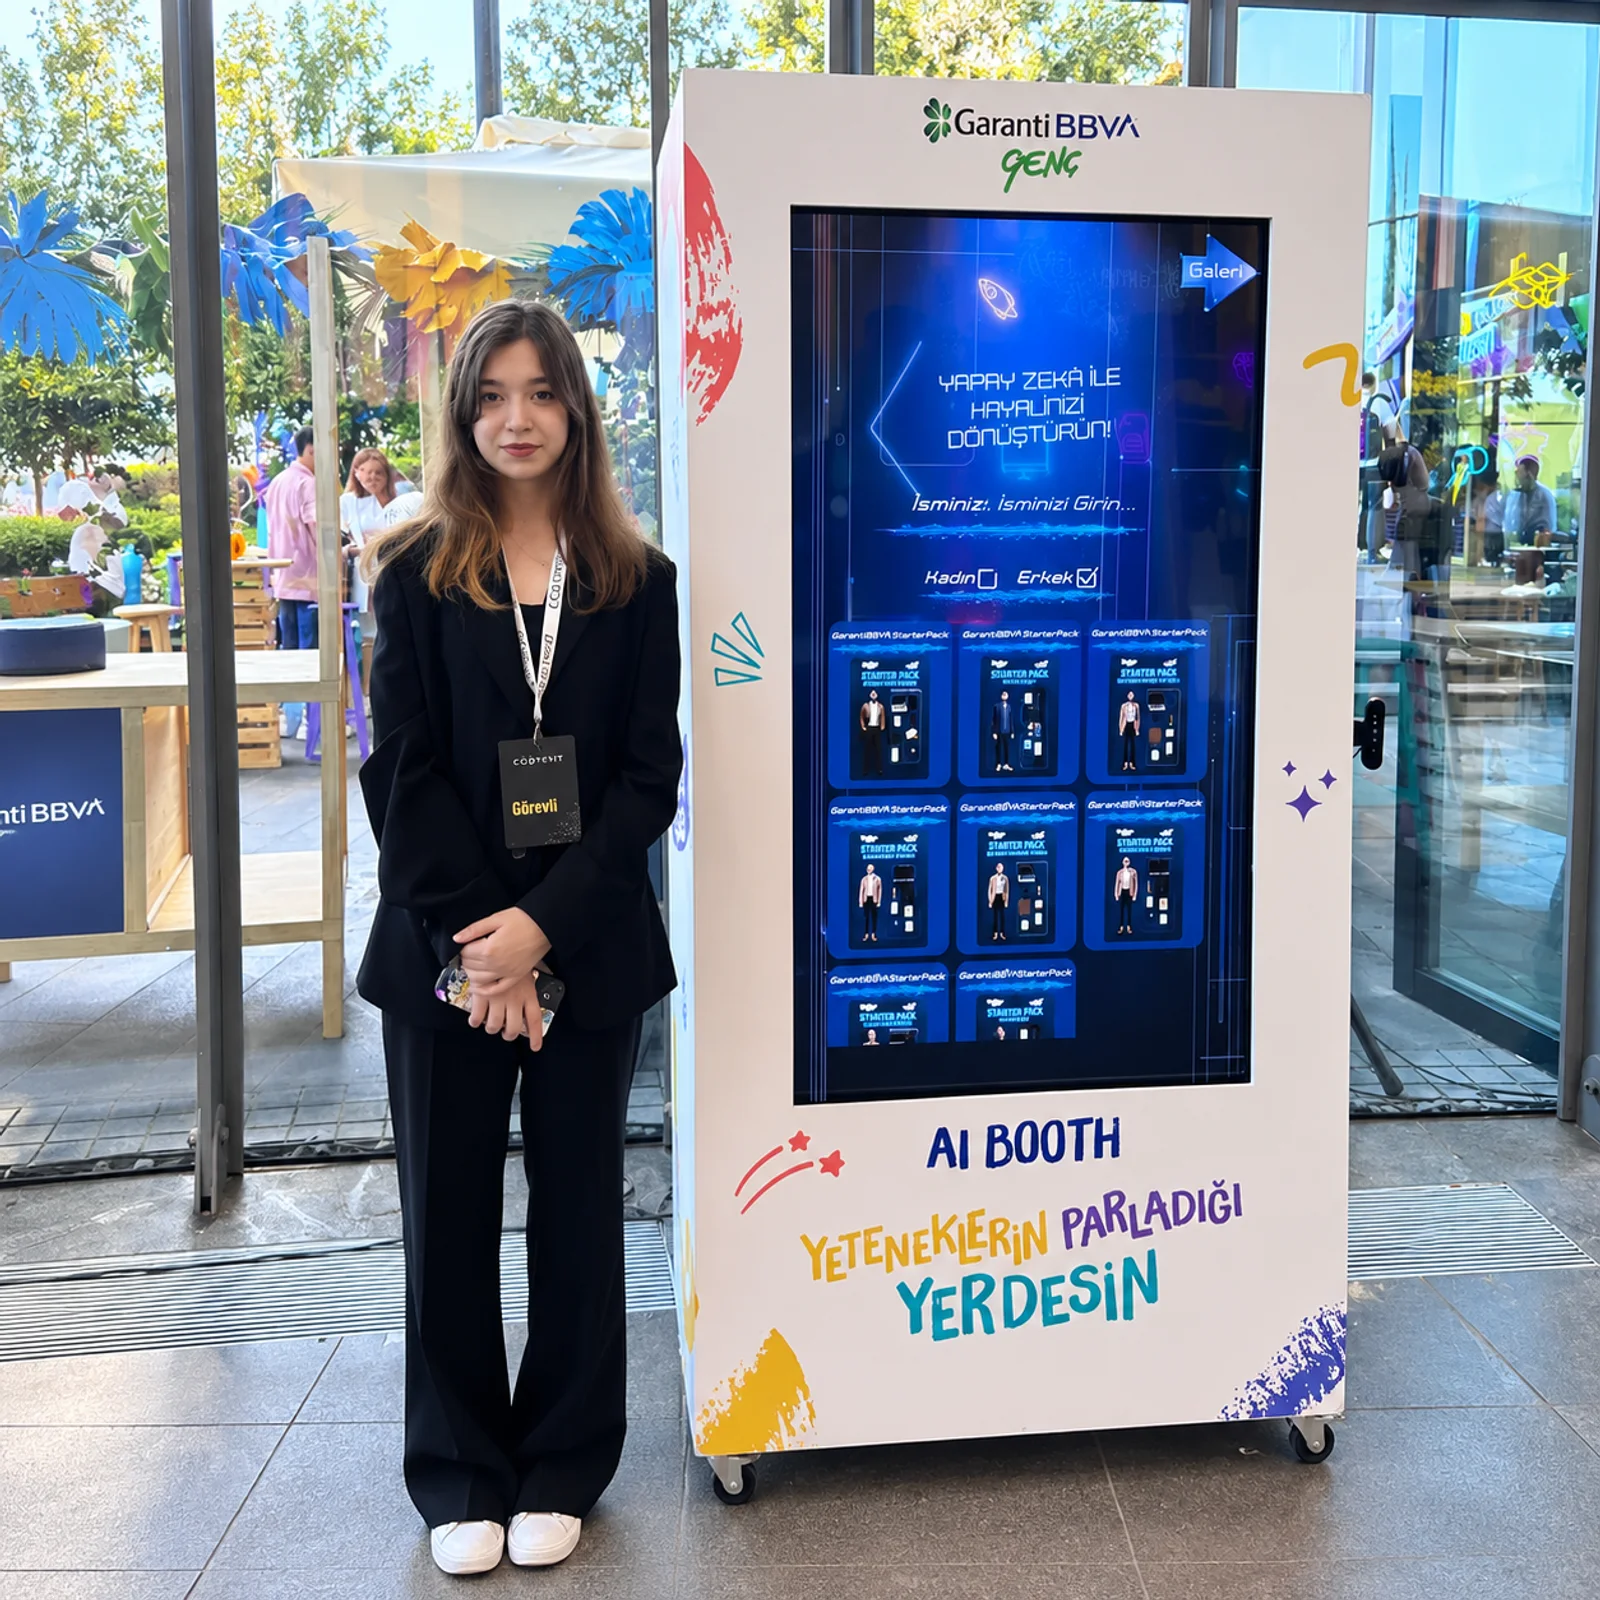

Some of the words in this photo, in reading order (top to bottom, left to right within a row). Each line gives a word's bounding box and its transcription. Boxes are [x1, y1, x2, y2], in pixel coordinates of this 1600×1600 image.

[954, 108, 1050, 138] Garanti
[1056, 113, 1140, 140] BBVA
[1189, 261, 1243, 278] Galeri
[938, 372, 1016, 393] YAPAY
[1089, 364, 1121, 387] İLE
[970, 392, 1085, 420] HAYALİNİZİ
[947, 417, 1112, 449] DÖNÜŞTÜRÜN!
[997, 493, 1069, 511] İsminizi
[1073, 494, 1136, 511] Girin...
[924, 570, 976, 585] Kadın
[1016, 570, 1074, 585] Erkek
[31, 798, 105, 823] BBVA
[512, 798, 558, 816] Görevli
[926, 1127, 969, 1169] AI
[985, 1117, 1121, 1169] BOOTH
[800, 1208, 1049, 1283] YETENEKLERİN
[1062, 1179, 1243, 1250] PARLADIĞI
[896, 1249, 1159, 1341] YERDESİN
